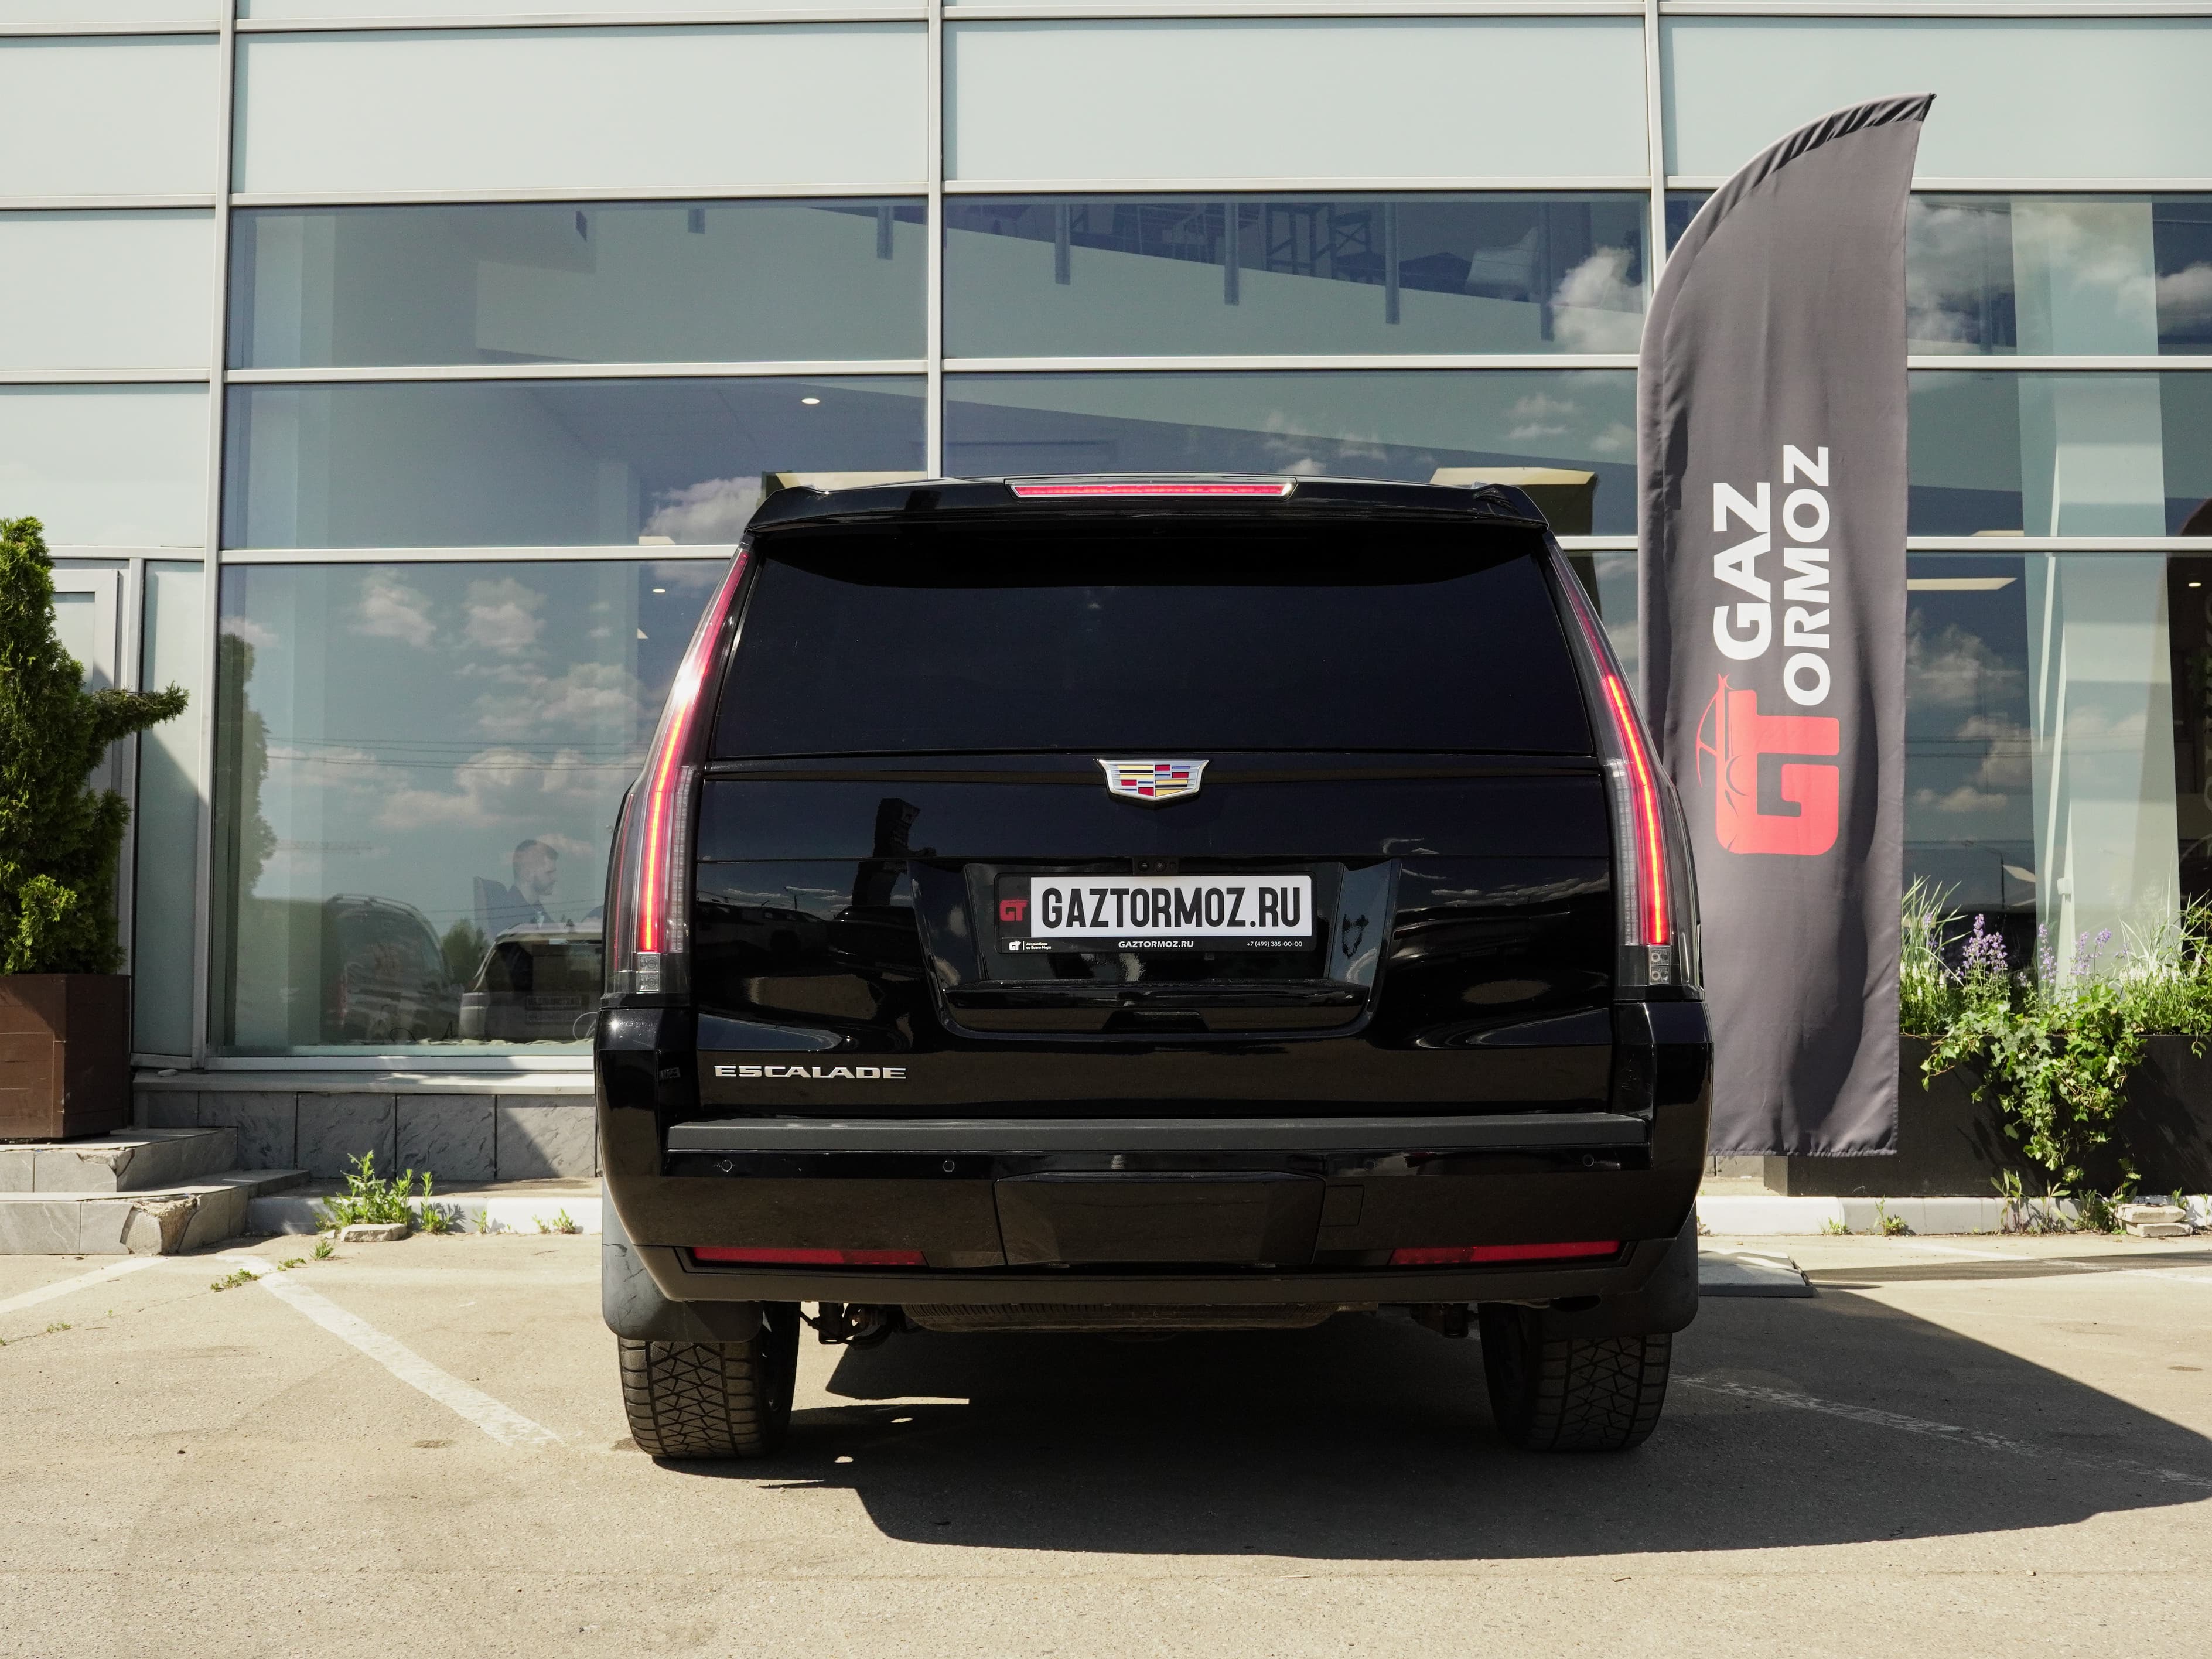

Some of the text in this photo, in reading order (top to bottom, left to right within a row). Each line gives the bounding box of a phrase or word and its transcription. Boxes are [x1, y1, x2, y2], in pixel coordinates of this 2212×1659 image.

[1713, 482, 1771, 660] GAZ
[1783, 445, 1830, 705] ORMOZ
[999, 900, 1028, 921] GT
[1042, 887, 1300, 929] GAZTORMOZ.RU
[714, 1066, 906, 1079] ESCALADE
